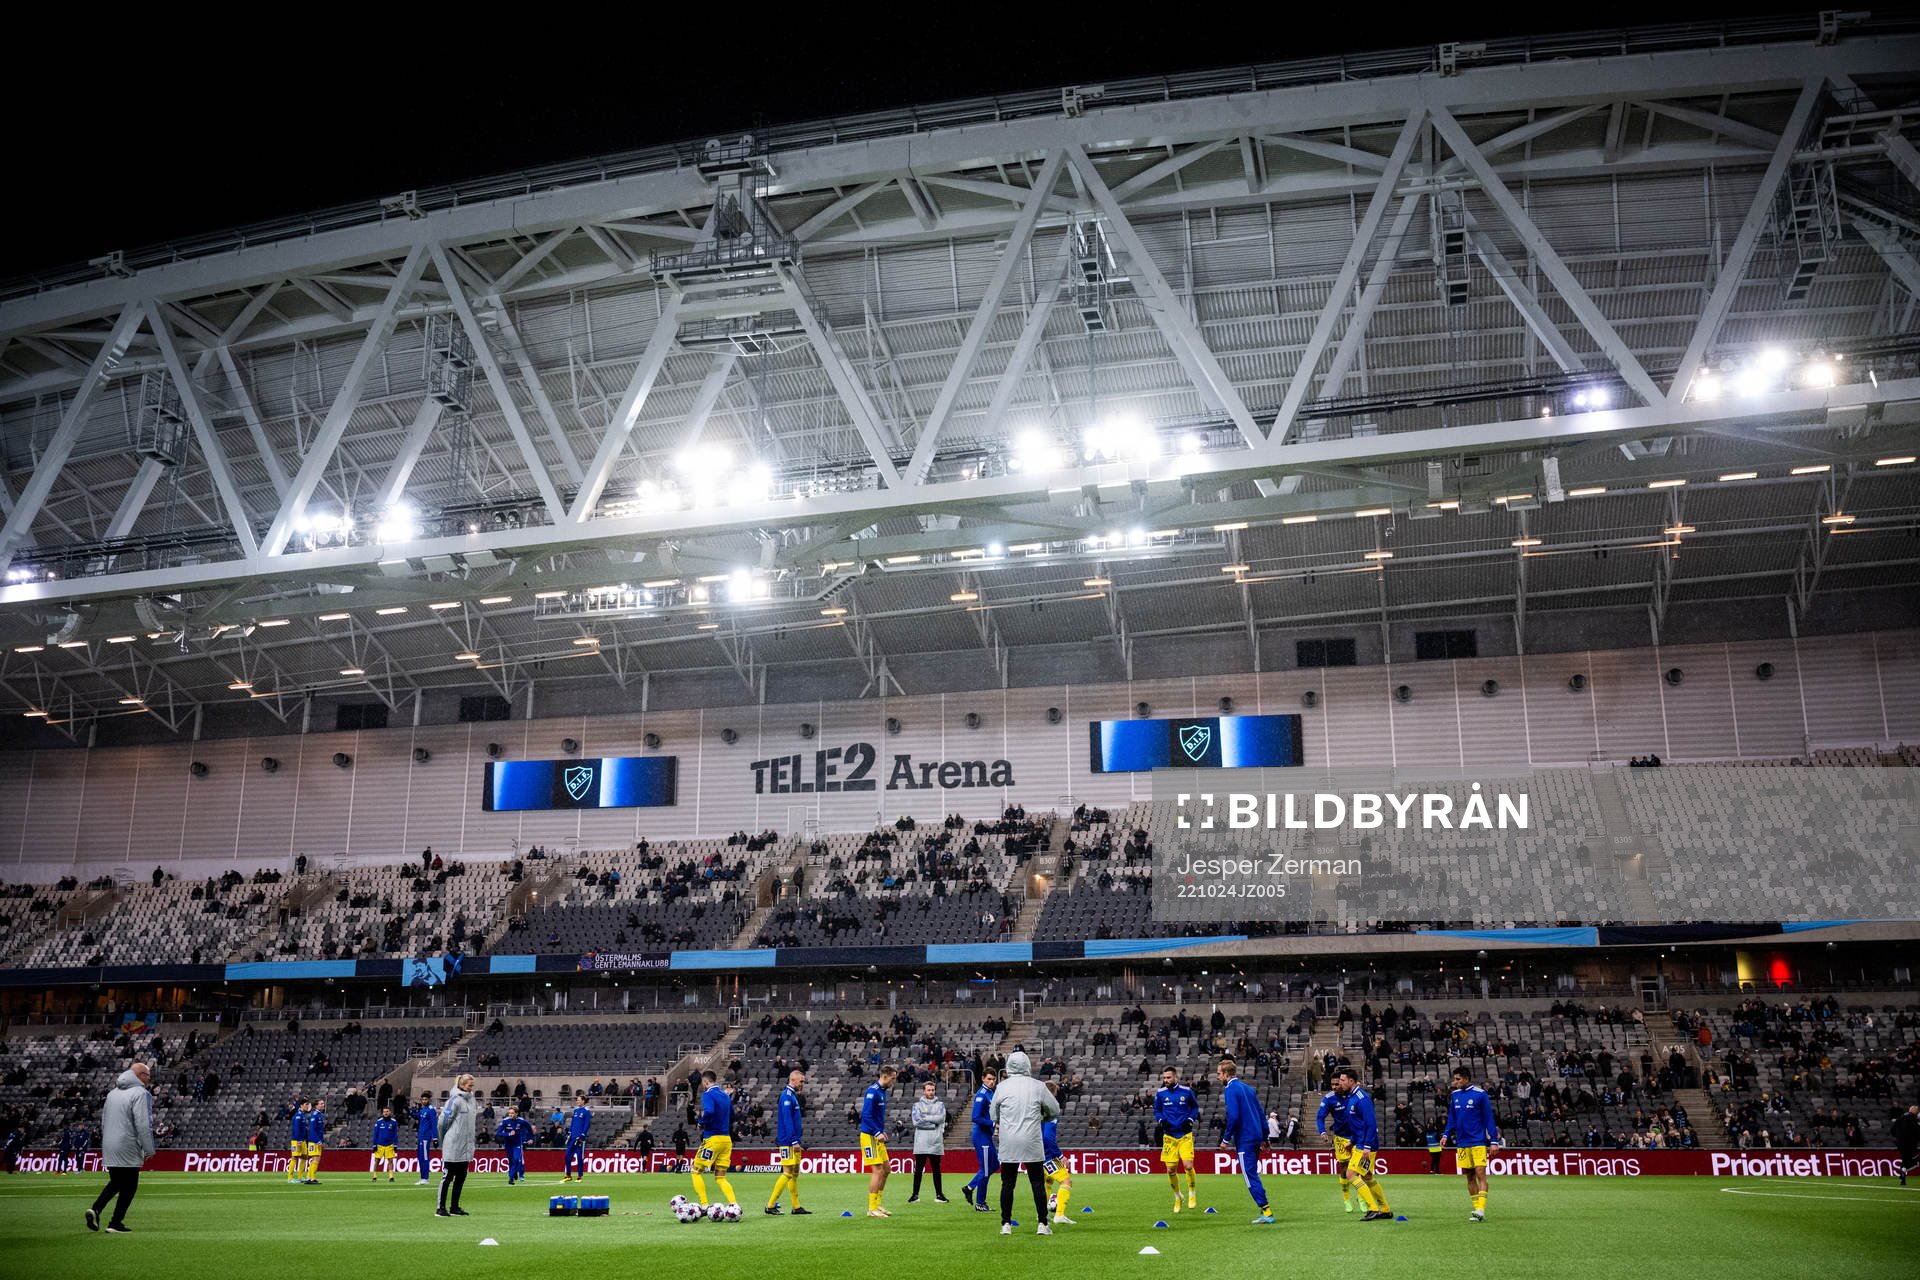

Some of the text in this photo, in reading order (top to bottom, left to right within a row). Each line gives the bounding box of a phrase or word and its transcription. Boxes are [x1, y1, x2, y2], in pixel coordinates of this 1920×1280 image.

[750, 742, 1015, 794] TELE2 Arena
[184, 1152, 316, 1172] Prioritet Fin
[1083, 1152, 1151, 1175] Finans
[1214, 1152, 1312, 1175] Proritet
[1456, 1152, 1641, 1176] ioritet Finans
[1711, 1152, 1903, 1177] Prioritet Finans
